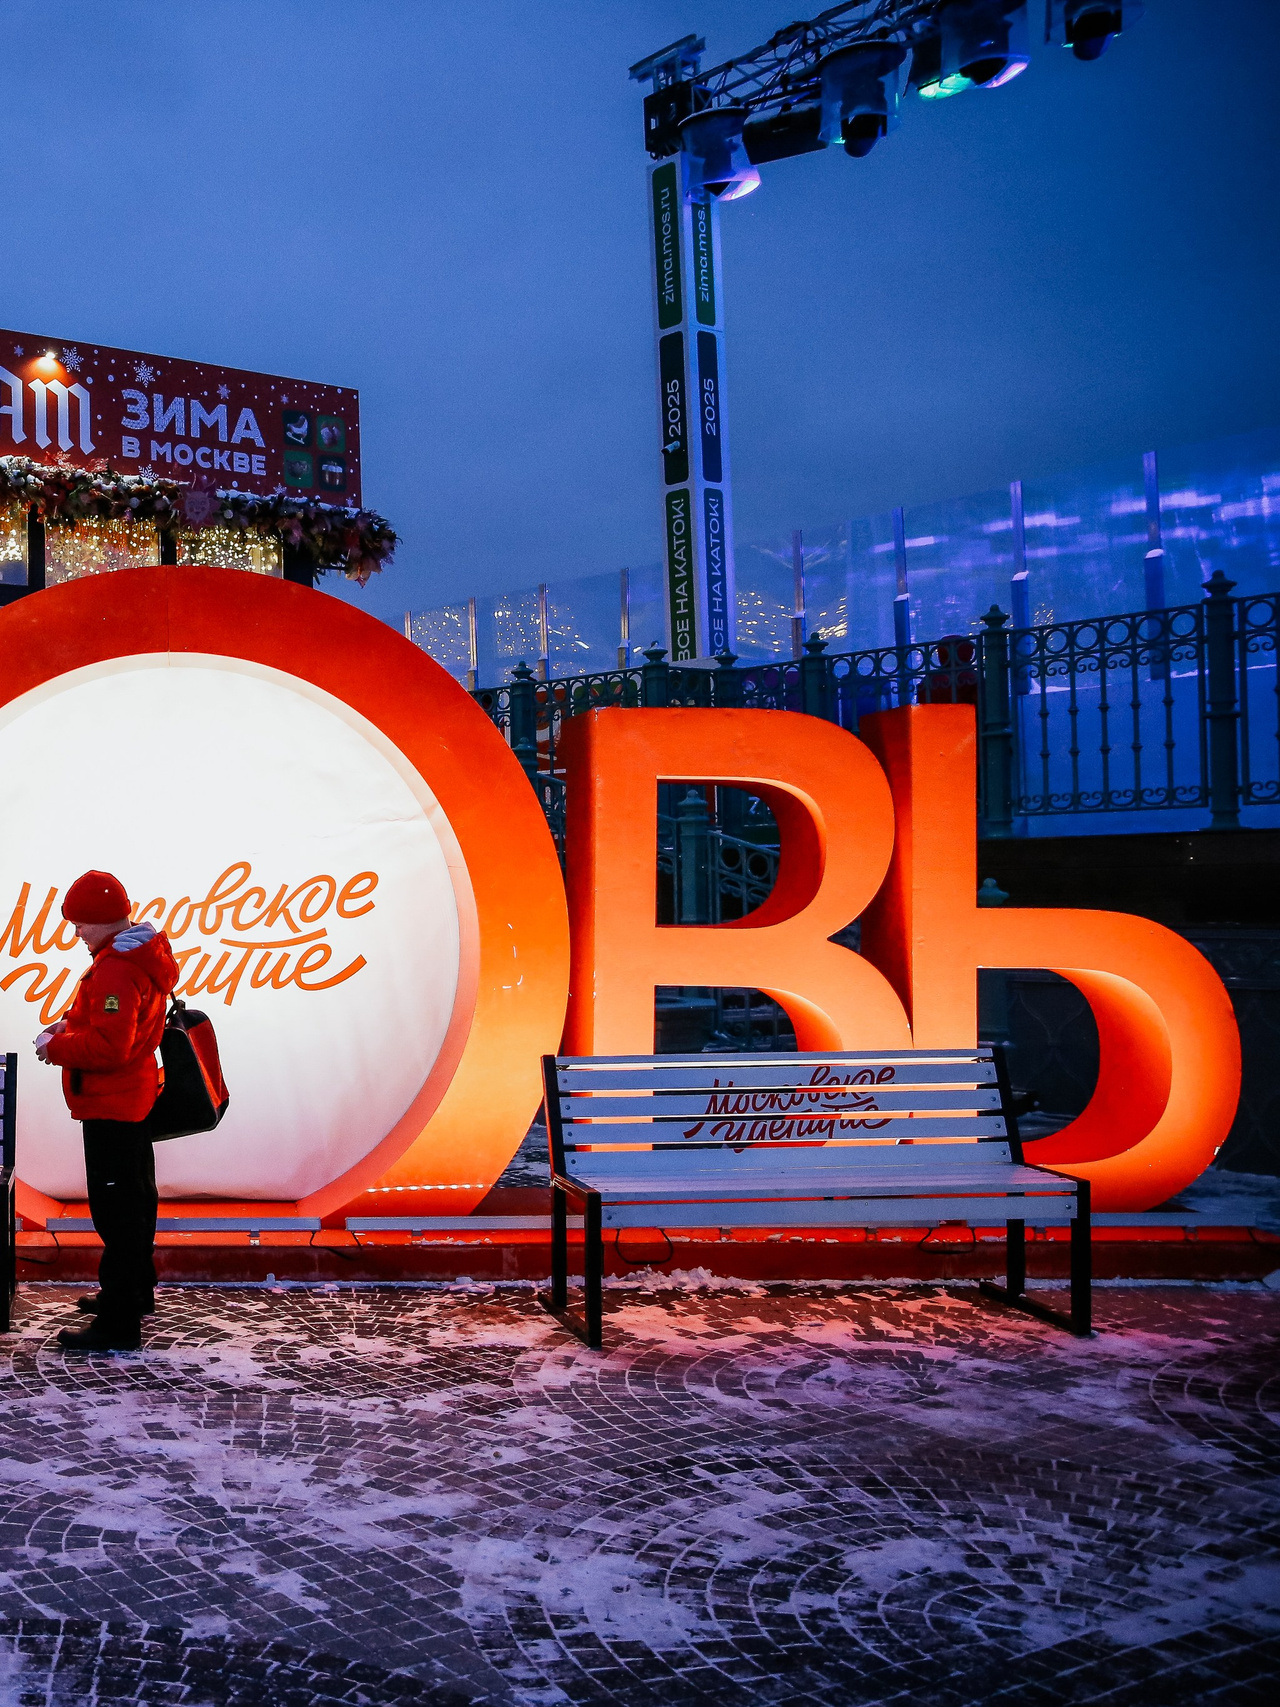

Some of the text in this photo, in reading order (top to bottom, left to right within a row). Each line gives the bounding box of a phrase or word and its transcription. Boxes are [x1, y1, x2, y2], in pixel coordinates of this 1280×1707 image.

[658, 187, 675, 305] zima.mos.ru
[121, 388, 266, 448] ЗИМА
[667, 379, 681, 437] 2025
[704, 378, 716, 436] 2025
[121, 436, 267, 476] В МОСКВЕ
[671, 498, 688, 577] КАТОК!
[709, 498, 721, 577] КАТОК!
[675, 581, 689, 614] НА
[712, 581, 722, 613] НА
